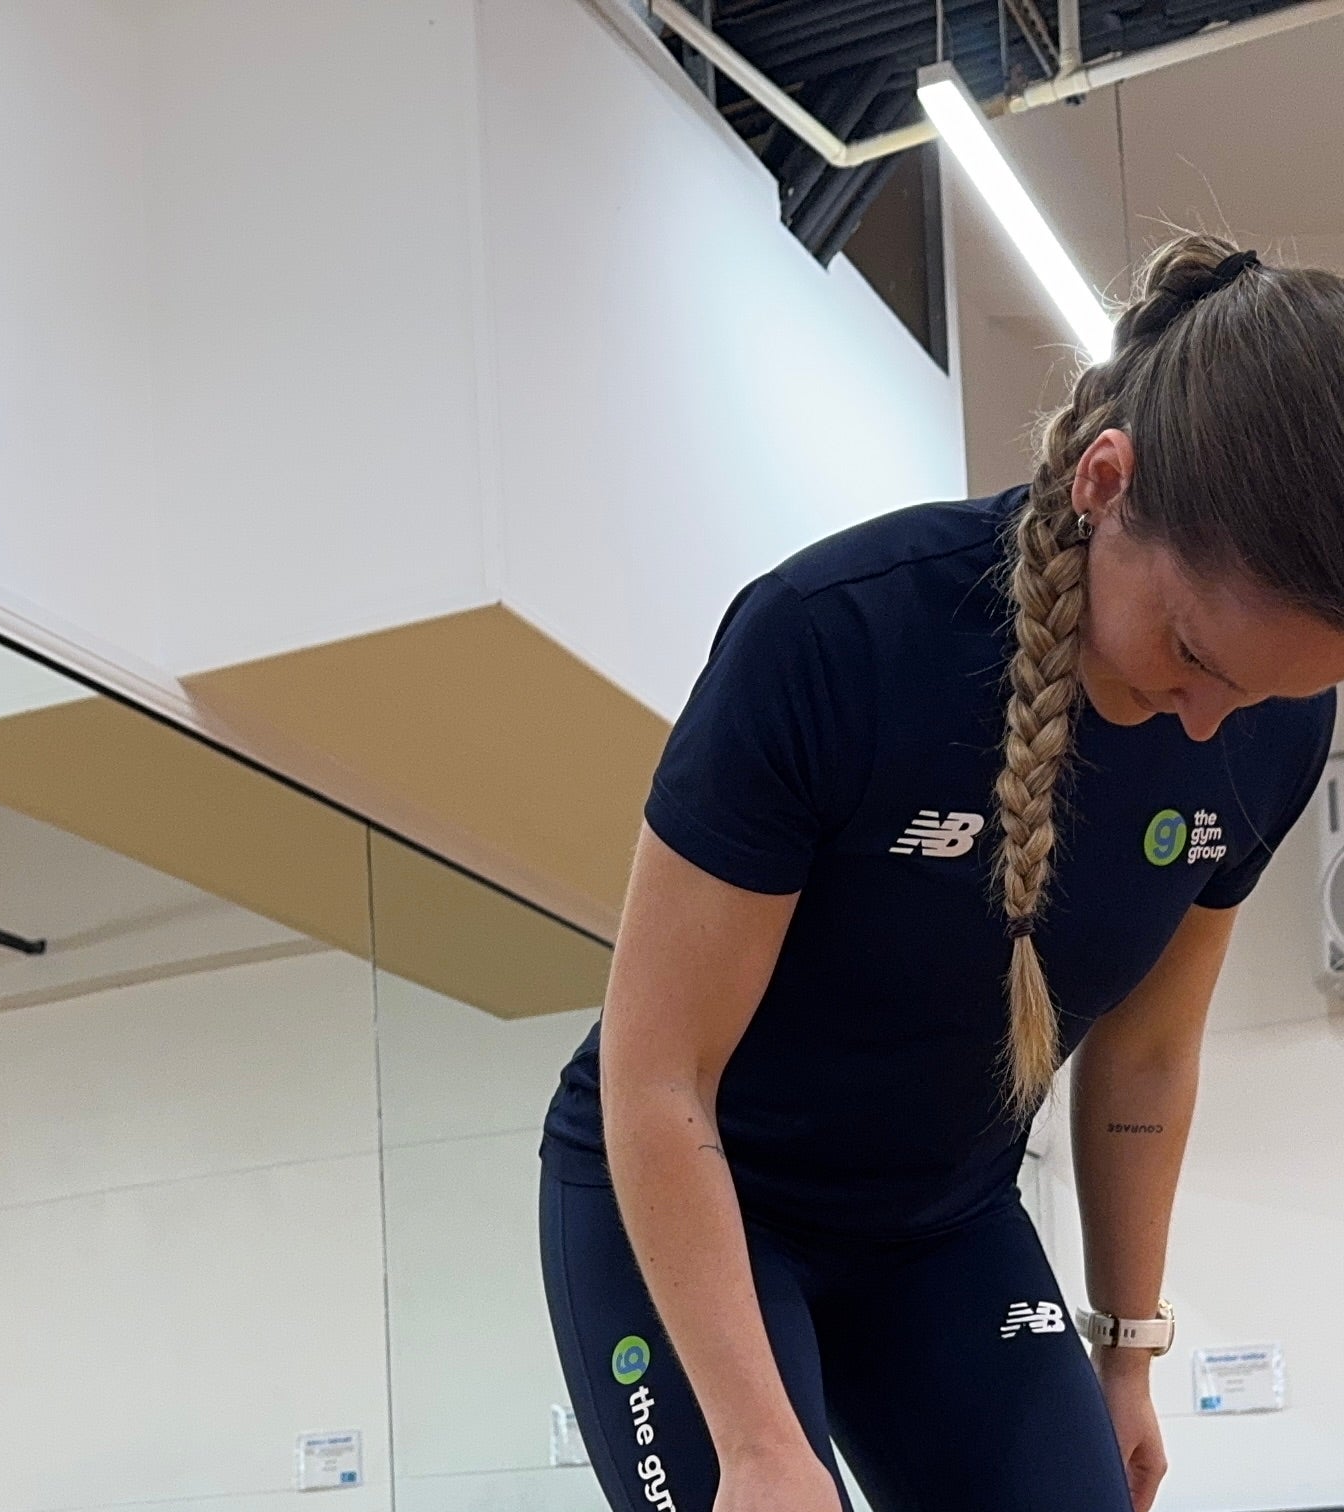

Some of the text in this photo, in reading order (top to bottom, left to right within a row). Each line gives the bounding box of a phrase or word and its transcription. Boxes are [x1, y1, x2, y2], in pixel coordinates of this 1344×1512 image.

[1194, 809, 1217, 826] the
[889, 810, 985, 858] NB
[1190, 826, 1222, 846] gym
[1187, 845, 1227, 865] group
[1108, 1123, 1164, 1134] COURAGE
[629, 1385, 655, 1446] the
